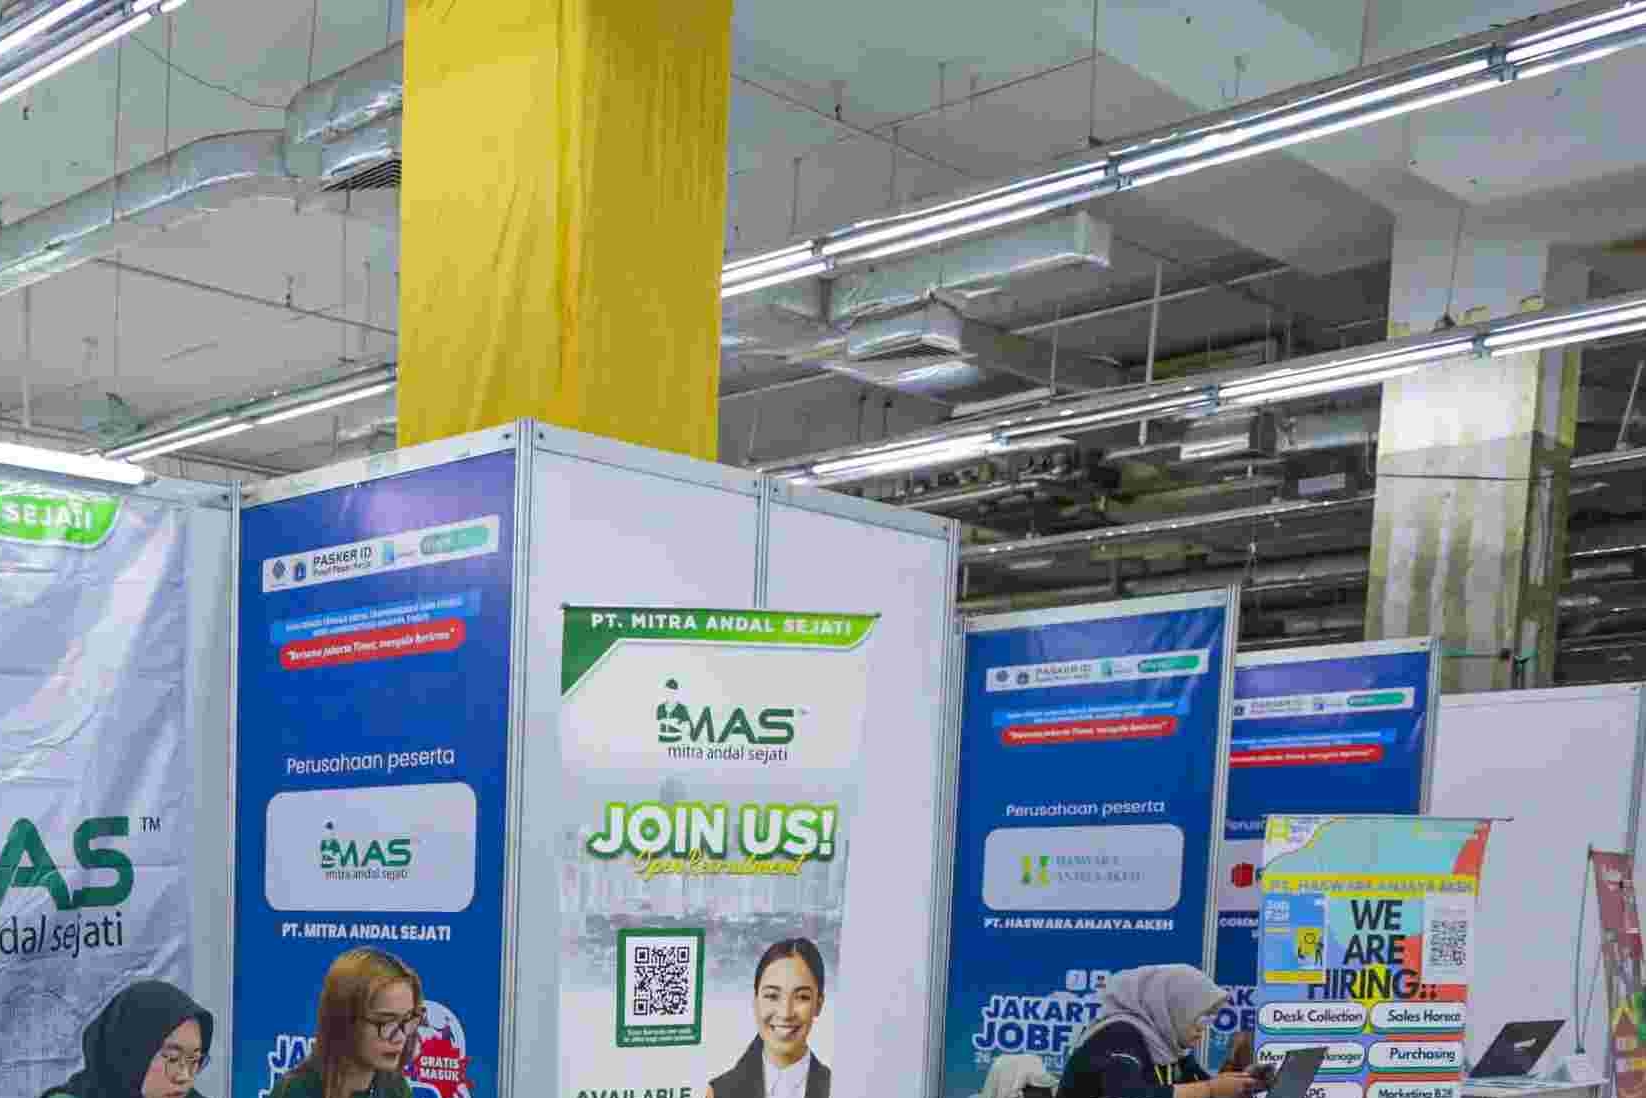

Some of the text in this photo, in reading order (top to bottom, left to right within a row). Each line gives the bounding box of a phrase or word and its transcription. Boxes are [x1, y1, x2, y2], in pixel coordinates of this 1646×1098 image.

[7, 500, 93, 531] SEJATI
[312, 549, 357, 568] PASKER
[590, 613, 852, 637] PT. MITRA ANDAL SEJATI
[286, 747, 456, 776] Perusahaan peserta
[667, 745, 788, 765] mitra andal sejati
[1006, 800, 1165, 818] Perusahaan peserta
[589, 803, 836, 861] JOIN US!
[984, 917, 1005, 929] PT.
[1005, 918, 1073, 930] HASWARA
[1075, 919, 1134, 931] ANJAYA
[1351, 899, 1403, 931] WE
[49, 911, 124, 959] sejati
[281, 923, 451, 942] PT. MITRA ANDAL SEJATI
[1341, 934, 1407, 965] ARE
[984, 999, 1104, 1022] JAKART
[1273, 1009, 1363, 1023] Desk Collection
[1387, 1010, 1421, 1022] Sales
[975, 1022, 1087, 1050] JOBF
[419, 1054, 460, 1071] GRATIS
[1321, 1052, 1363, 1064] anager
[1389, 1047, 1456, 1063] Purchasing
[419, 1068, 460, 1082] MASUK
